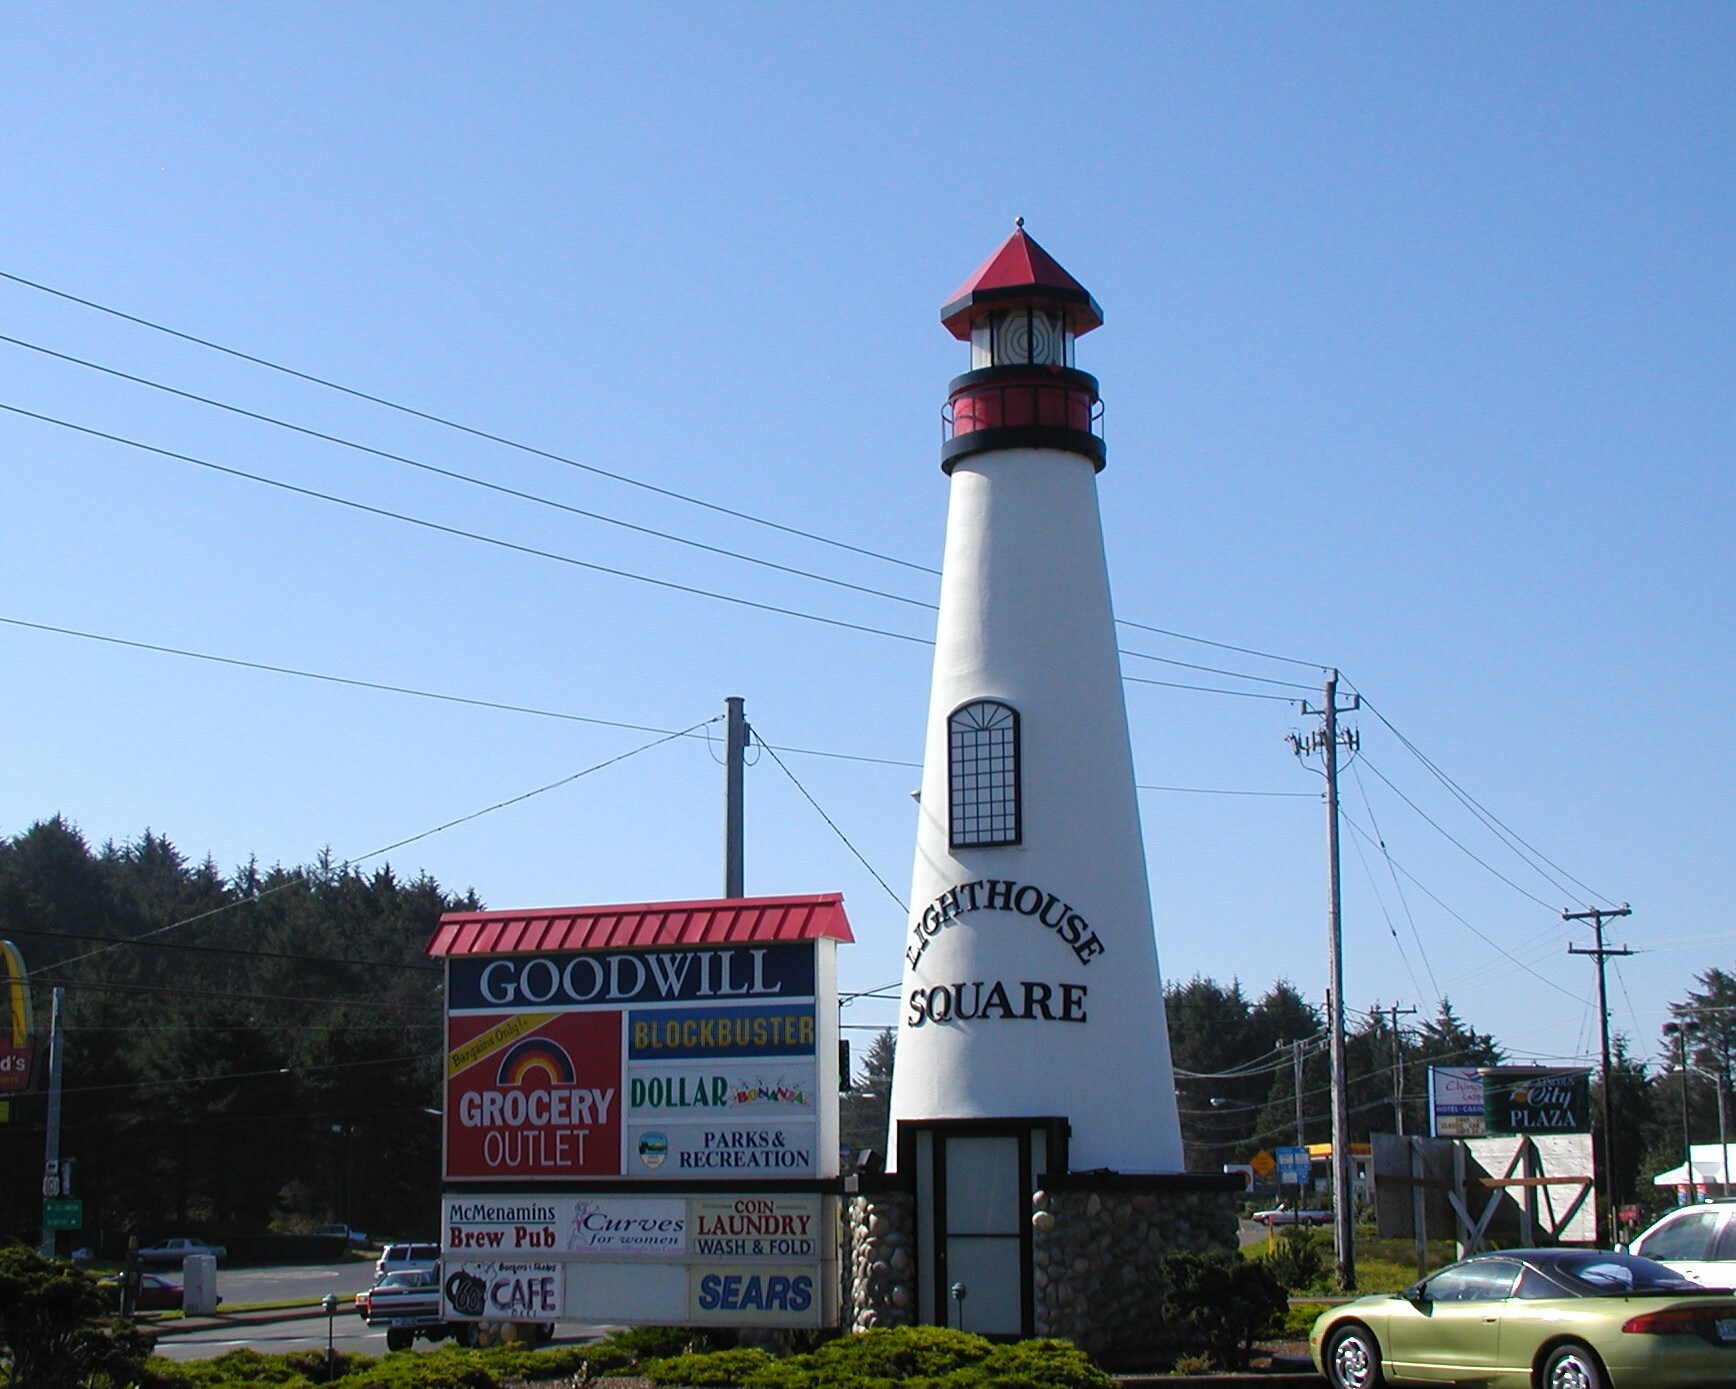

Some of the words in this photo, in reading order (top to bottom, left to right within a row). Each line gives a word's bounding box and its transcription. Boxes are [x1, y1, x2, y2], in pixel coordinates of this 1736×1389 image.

[906, 879, 1105, 971] LIGHTHOUSE
[479, 949, 782, 1004] GOODWILL
[908, 981, 1088, 1028] SQUARE
[633, 1016, 814, 1049] BLOCKBUSTER
[452, 1037, 495, 1067] Bargains
[630, 1076, 728, 1108] DOLLAR
[736, 1086, 804, 1104] BONANZA
[1527, 1087, 1572, 1109] City
[459, 1088, 615, 1127] GROCERY
[1510, 1110, 1577, 1127] PLAZA
[484, 1130, 589, 1166] OUTLET
[704, 1131, 769, 1148] PARKS
[680, 1150, 810, 1168] RECREATION
[450, 1203, 556, 1221] McMenamins
[734, 1200, 774, 1214] COIN
[583, 1213, 685, 1232] Curves
[698, 1215, 811, 1235] LAUNDRY
[450, 1226, 505, 1248] Brew
[514, 1226, 556, 1248] Pub
[589, 1233, 614, 1246] for
[619, 1236, 678, 1245] women
[698, 1240, 746, 1254] WASH
[752, 1240, 763, 1254] &
[770, 1240, 811, 1254] FOLD
[491, 1276, 556, 1311] CAFE
[699, 1274, 813, 1312] SEARS
